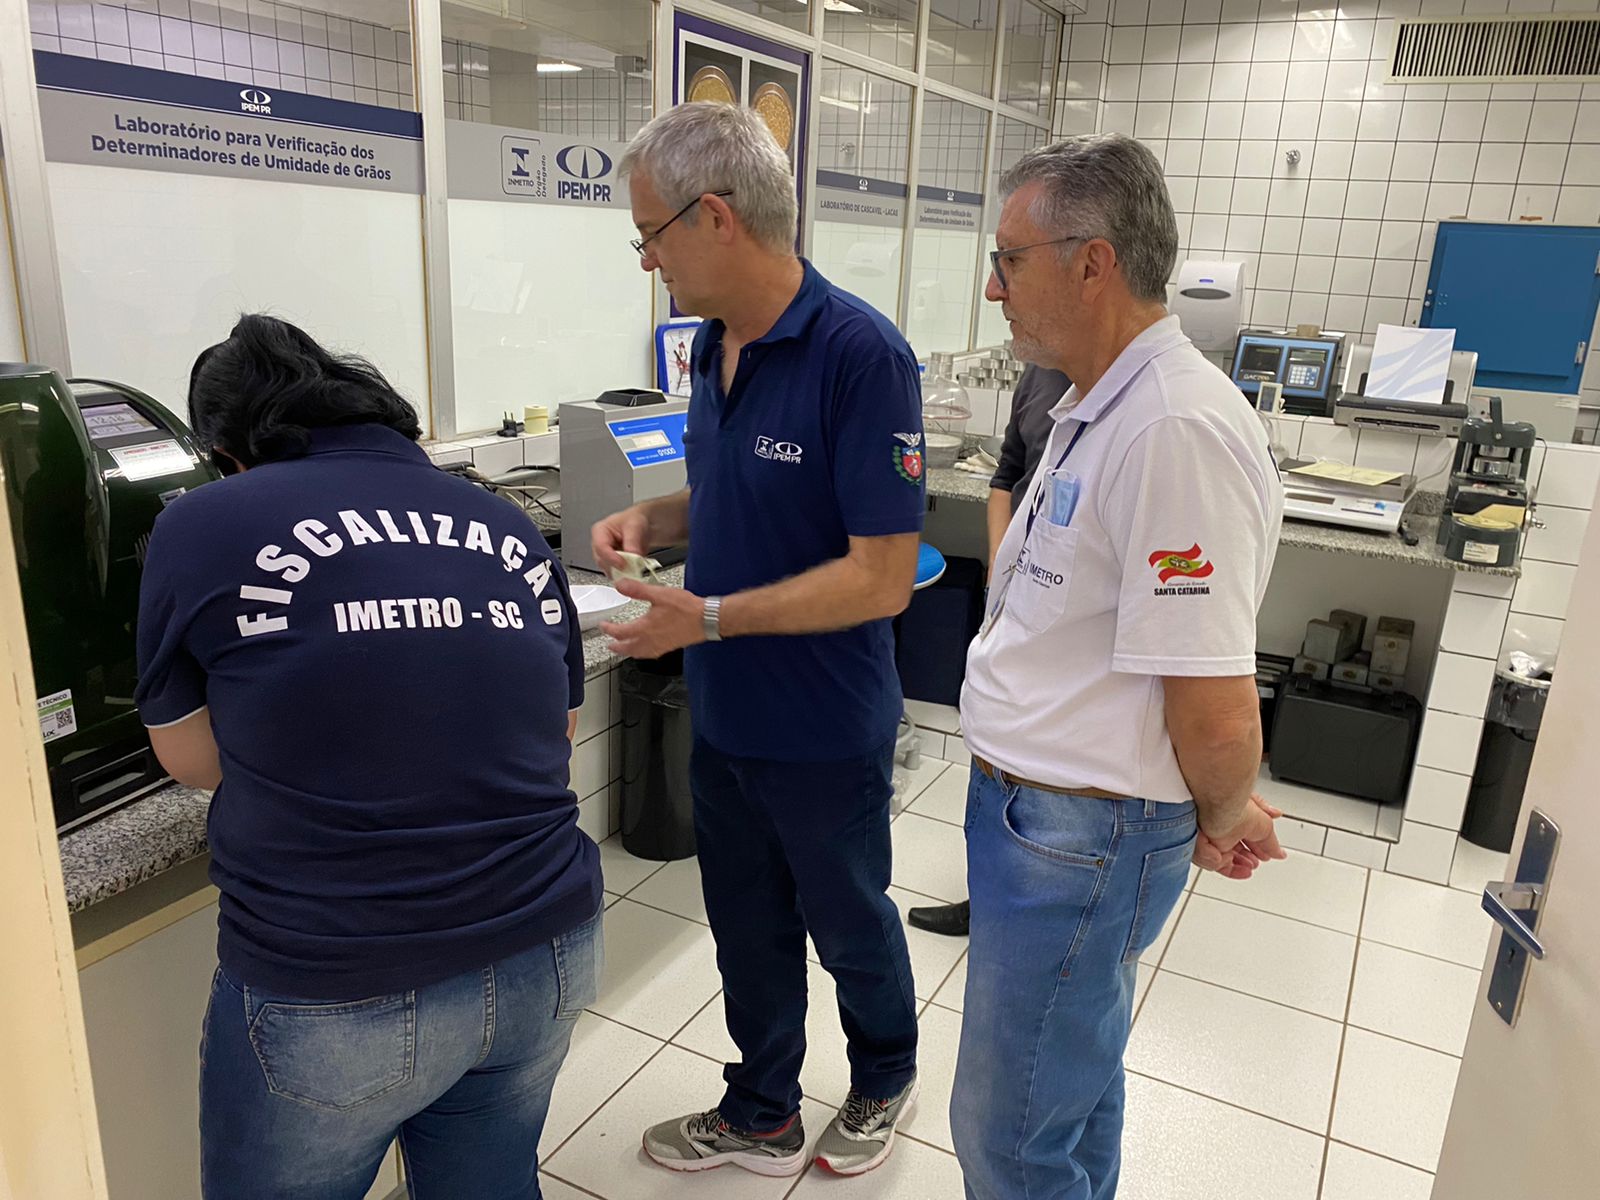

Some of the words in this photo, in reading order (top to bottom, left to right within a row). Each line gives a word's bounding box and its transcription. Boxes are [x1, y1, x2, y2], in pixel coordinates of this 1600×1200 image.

[241, 102, 260, 113] IPEM
[260, 104, 272, 115] PR
[114, 114, 221, 142] Laboratório
[225, 131, 261, 147] para
[265, 133, 347, 157] Verificação
[350, 144, 375, 160] dos
[91, 135, 237, 165] Determinadores
[241, 152, 261, 167] de
[264, 154, 330, 174] Umidade
[333, 162, 350, 176] de
[354, 164, 391, 181] Grãos
[557, 181, 591, 201] IPEM
[593, 183, 611, 202] PR
[820, 200, 854, 212] LABORATÓRIO
[854, 204, 860, 212] DE
[861, 205, 882, 216] CASCAVEL
[773, 452, 791, 462] IPEM
[791, 455, 802, 464] PR
[236, 509, 563, 637] FISCALIZAÇÃO
[1154, 588, 1177, 596] SANTA
[1177, 586, 1210, 596] CATARINA
[333, 597, 463, 633] IMETRO
[490, 600, 525, 630] SC
